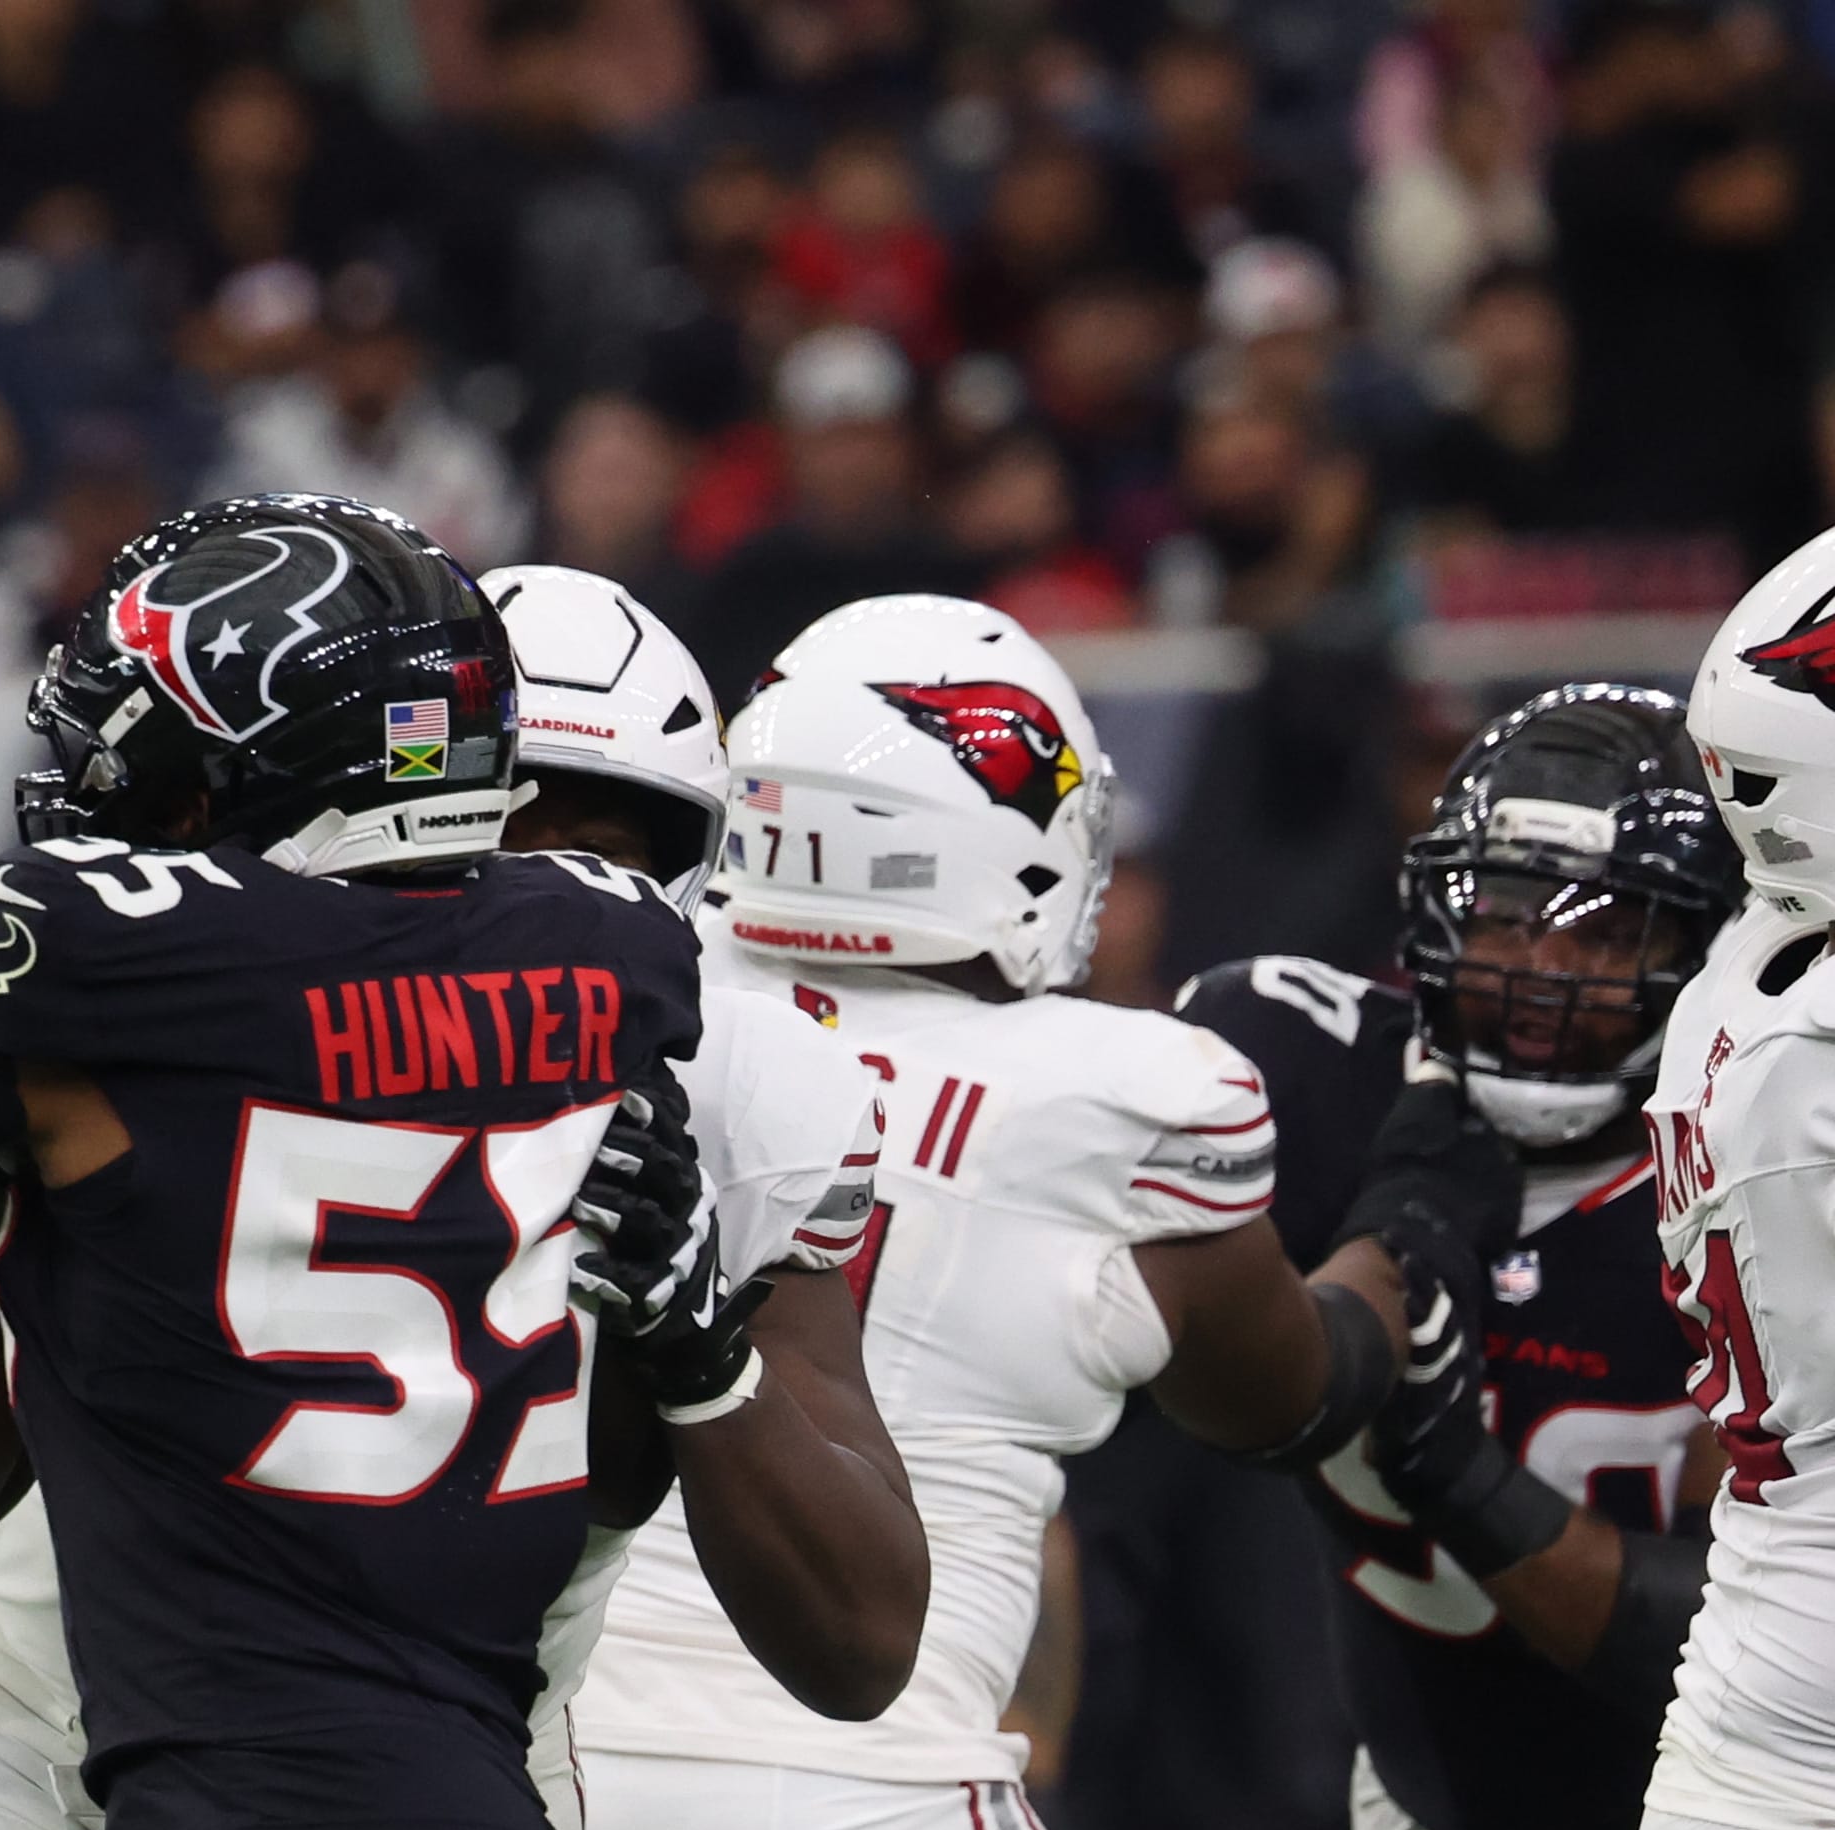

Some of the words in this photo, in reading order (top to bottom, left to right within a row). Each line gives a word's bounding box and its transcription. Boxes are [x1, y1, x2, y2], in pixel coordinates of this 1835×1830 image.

[519, 716, 616, 740] CARDINALS
[762, 823, 823, 884] 71
[303, 966, 622, 1105] HUNTER
